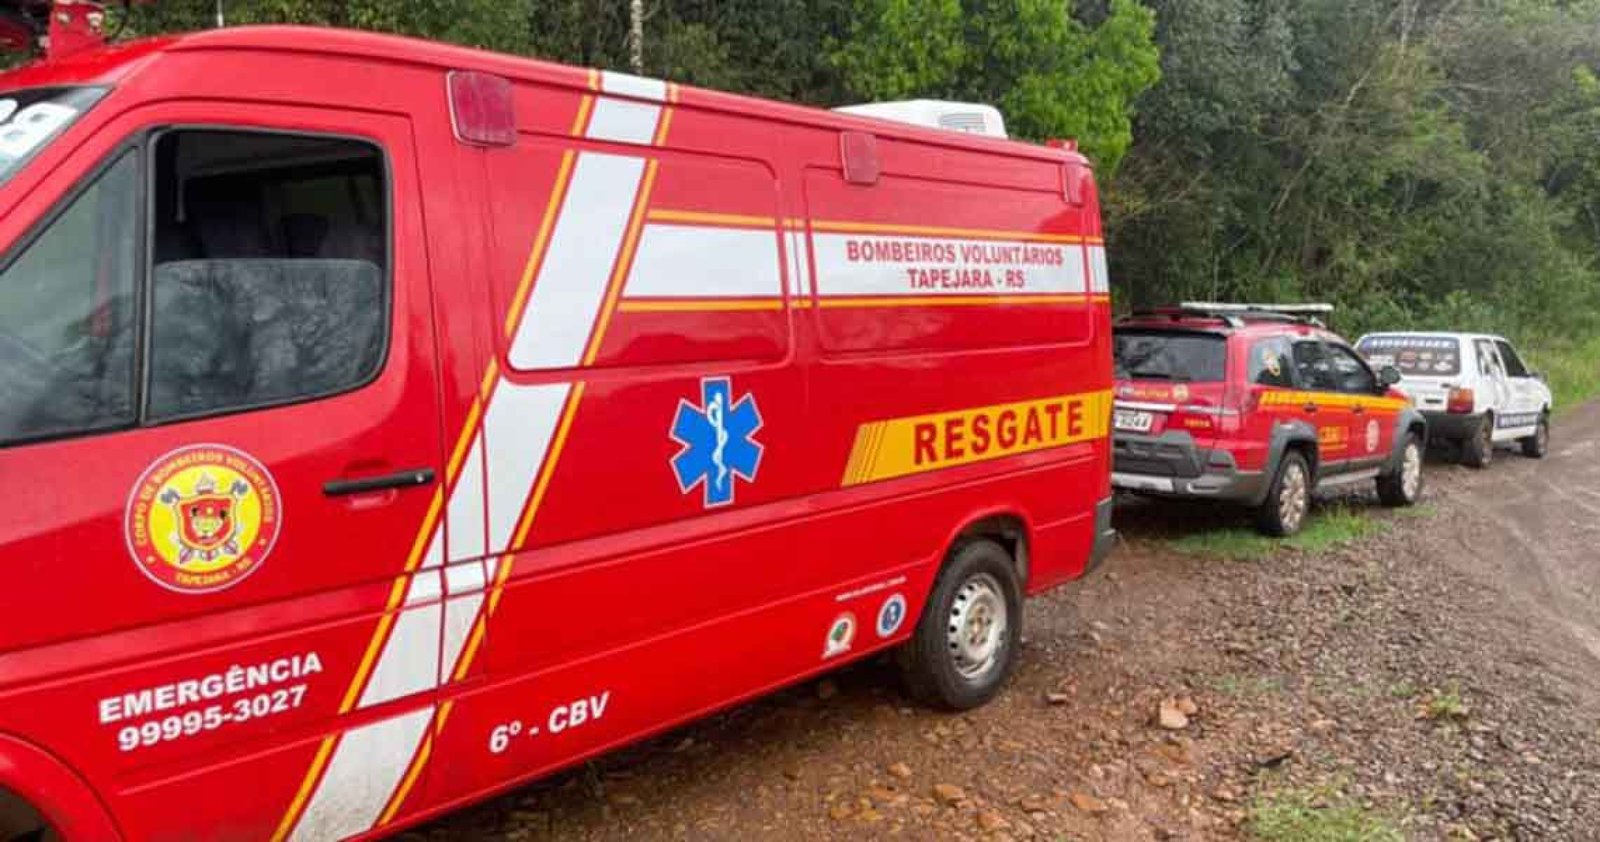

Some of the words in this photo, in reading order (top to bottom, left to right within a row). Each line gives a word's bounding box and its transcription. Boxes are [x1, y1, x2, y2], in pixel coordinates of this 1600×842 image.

[846, 241, 955, 263] BOMBEIROS
[961, 243, 1064, 266] VOLUNTÁRIOS
[907, 268, 993, 289] TAPEJARA
[1005, 270, 1025, 287] RS
[913, 399, 1084, 466] RESGATE
[135, 501, 148, 546] CORPO
[153, 452, 224, 484] BOMBEIROS
[175, 571, 231, 585] TAPEJARA
[99, 651, 323, 723] EMERGÊNCIA
[548, 692, 611, 736] CBV
[117, 684, 309, 752] 99995-3027
